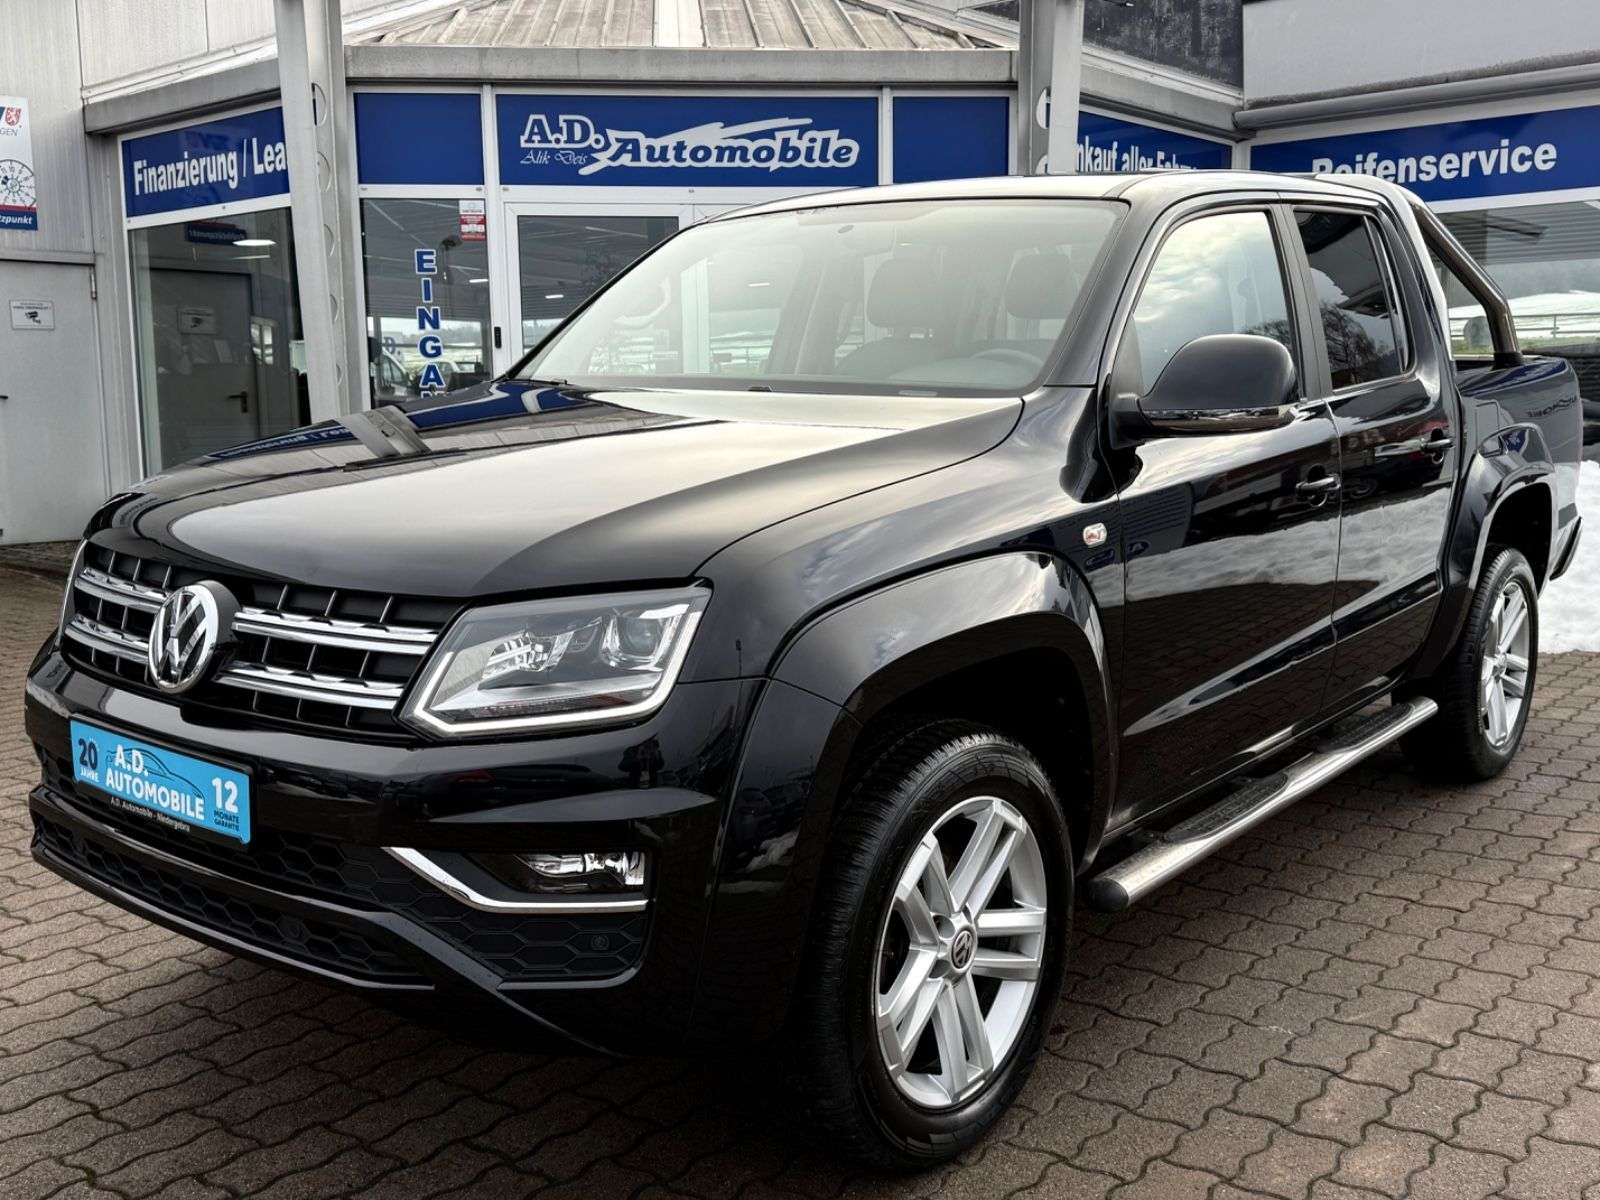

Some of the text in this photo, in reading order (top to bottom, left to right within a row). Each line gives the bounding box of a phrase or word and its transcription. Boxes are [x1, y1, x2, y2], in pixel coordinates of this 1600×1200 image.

[520, 114, 859, 170] A.D. Automobile
[1076, 135, 1118, 172] nkauf
[134, 150, 238, 196] Finanzierung
[252, 137, 287, 175] Lea
[78, 738, 98, 770] 20
[115, 744, 149, 777] A.D.
[105, 767, 205, 820] AUTOMOBILE
[211, 777, 239, 814] 12
